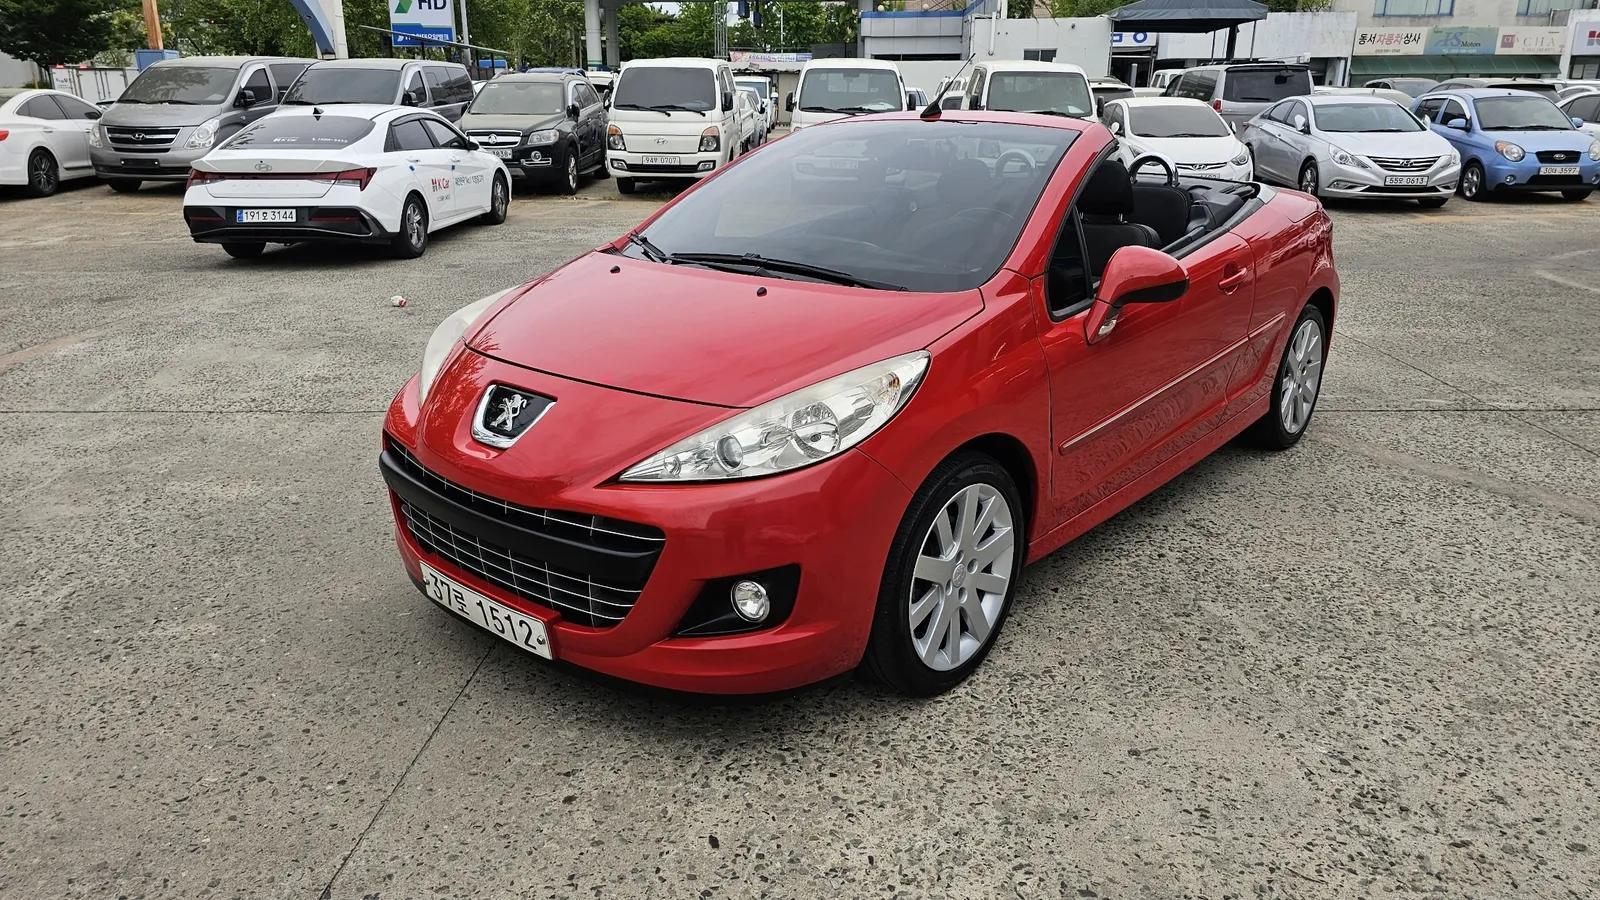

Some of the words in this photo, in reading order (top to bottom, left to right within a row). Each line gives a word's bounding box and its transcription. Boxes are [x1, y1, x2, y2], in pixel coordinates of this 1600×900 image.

[1358, 33, 1421, 45] 동서자동차상사
[271, 211, 294, 220] 3144
[430, 572, 470, 616] 37로
[475, 600, 537, 651] 1512
